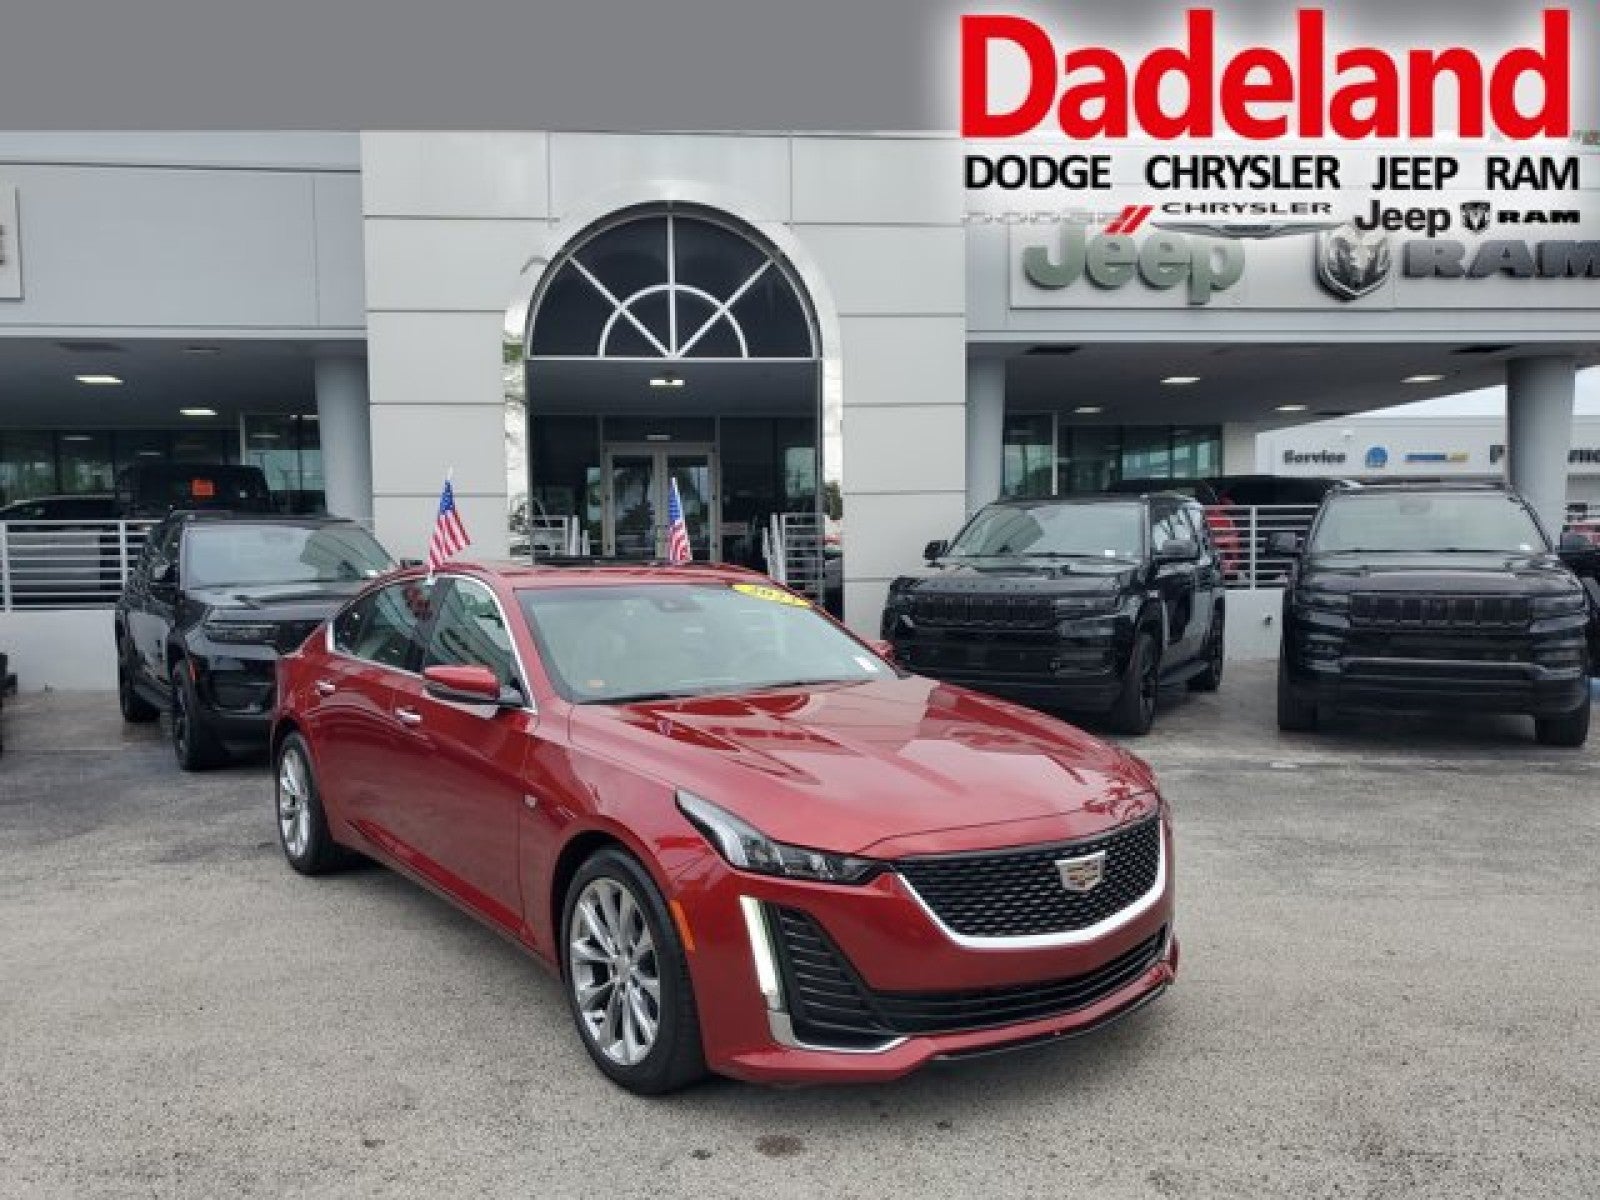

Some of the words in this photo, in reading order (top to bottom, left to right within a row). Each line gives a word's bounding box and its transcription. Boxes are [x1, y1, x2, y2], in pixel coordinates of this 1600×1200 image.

[1022, 209, 1245, 305] Jeep
[1402, 239, 1600, 279] RAM
[1283, 449, 1346, 464] Service
